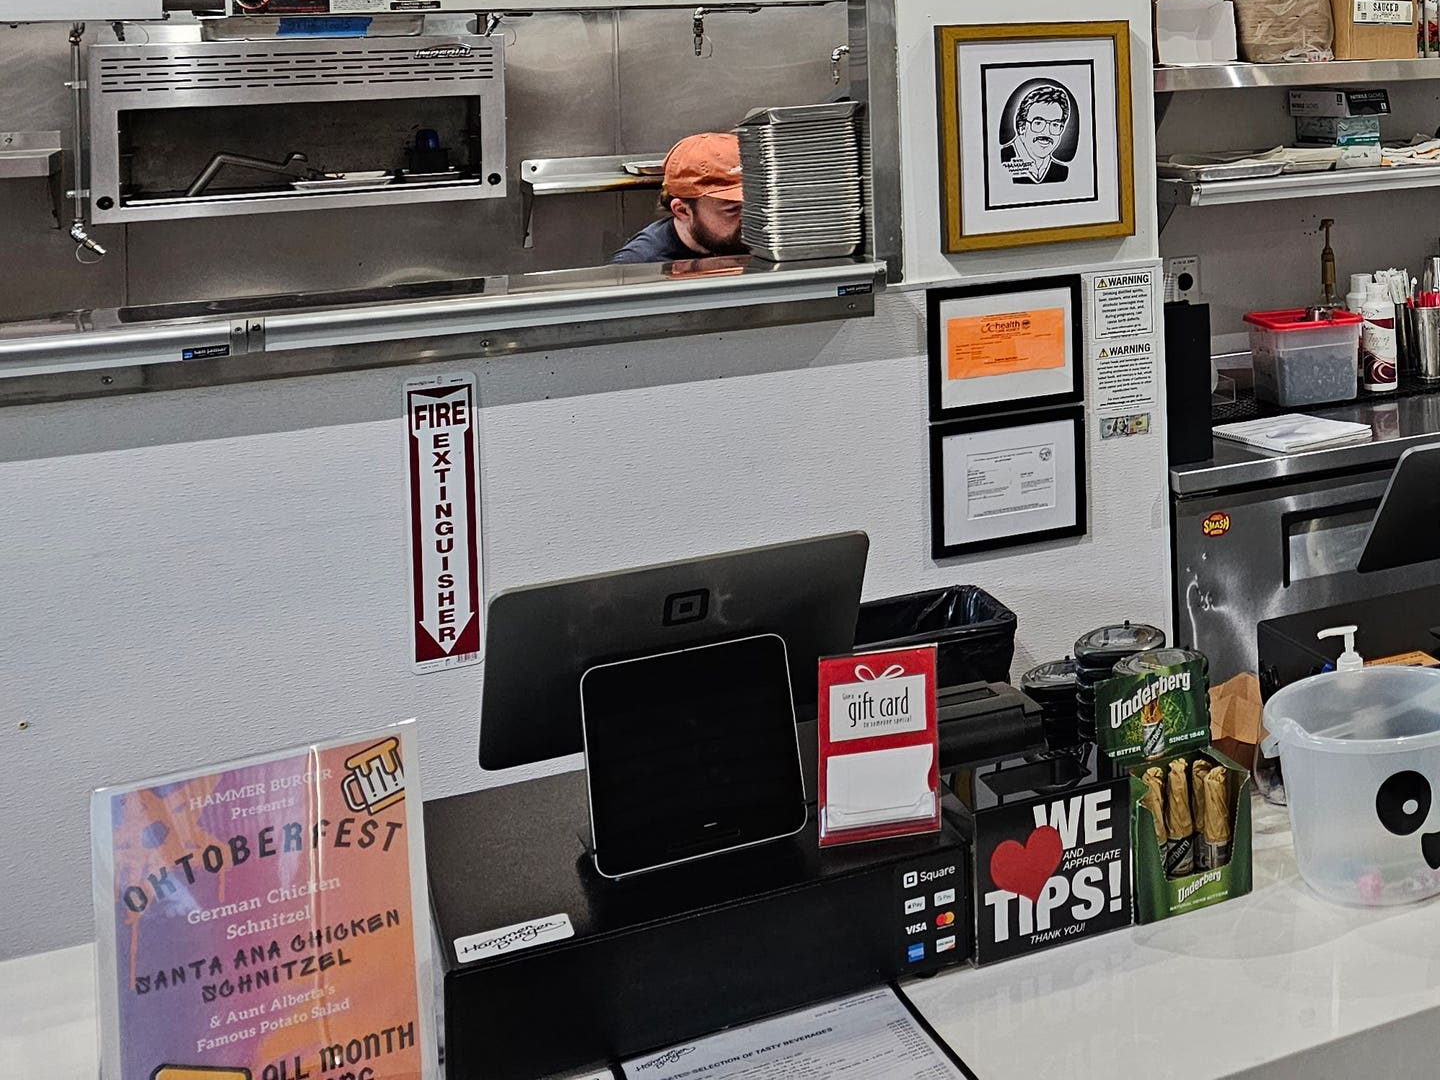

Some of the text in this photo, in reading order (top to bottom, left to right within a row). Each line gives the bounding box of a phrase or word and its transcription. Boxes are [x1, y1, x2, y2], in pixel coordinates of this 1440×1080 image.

[1108, 274, 1149, 286] WARNING
[1109, 343, 1151, 356] WARNING
[414, 400, 466, 430] FIRE
[432, 432, 456, 643] EXTINGUISHER
[1203, 515, 1230, 534] SMASH
[848, 687, 908, 727] gift card
[1109, 669, 1191, 729] Underberg
[1117, 734, 1188, 757] BITTER SINCE
[189, 783, 266, 811] HAMMER
[231, 795, 295, 821] Presents
[1033, 789, 1112, 851] WE
[123, 817, 403, 913] OKTOBERFEST
[1062, 847, 1084, 861] AND
[1062, 848, 1121, 871] APPRECIATE
[919, 865, 955, 883] Square
[1177, 868, 1221, 903] Underberg
[186, 876, 342, 925] German Chicken
[984, 861, 1122, 943] TIPS!
[225, 904, 312, 941] Schnitzel
[492, 921, 566, 950] Burger
[905, 921, 927, 935] VISA
[1030, 922, 1086, 945] THANK YOU!
[135, 908, 401, 996] SANTA ANA CHICKEN
[460, 925, 536, 954] Hammer
[201, 948, 352, 1004] SCHNITZEL
[209, 983, 336, 1029] & Aunt Alberta's
[196, 998, 351, 1053] Famous Potato Salad
[755, 1040, 781, 1055] TASTY
